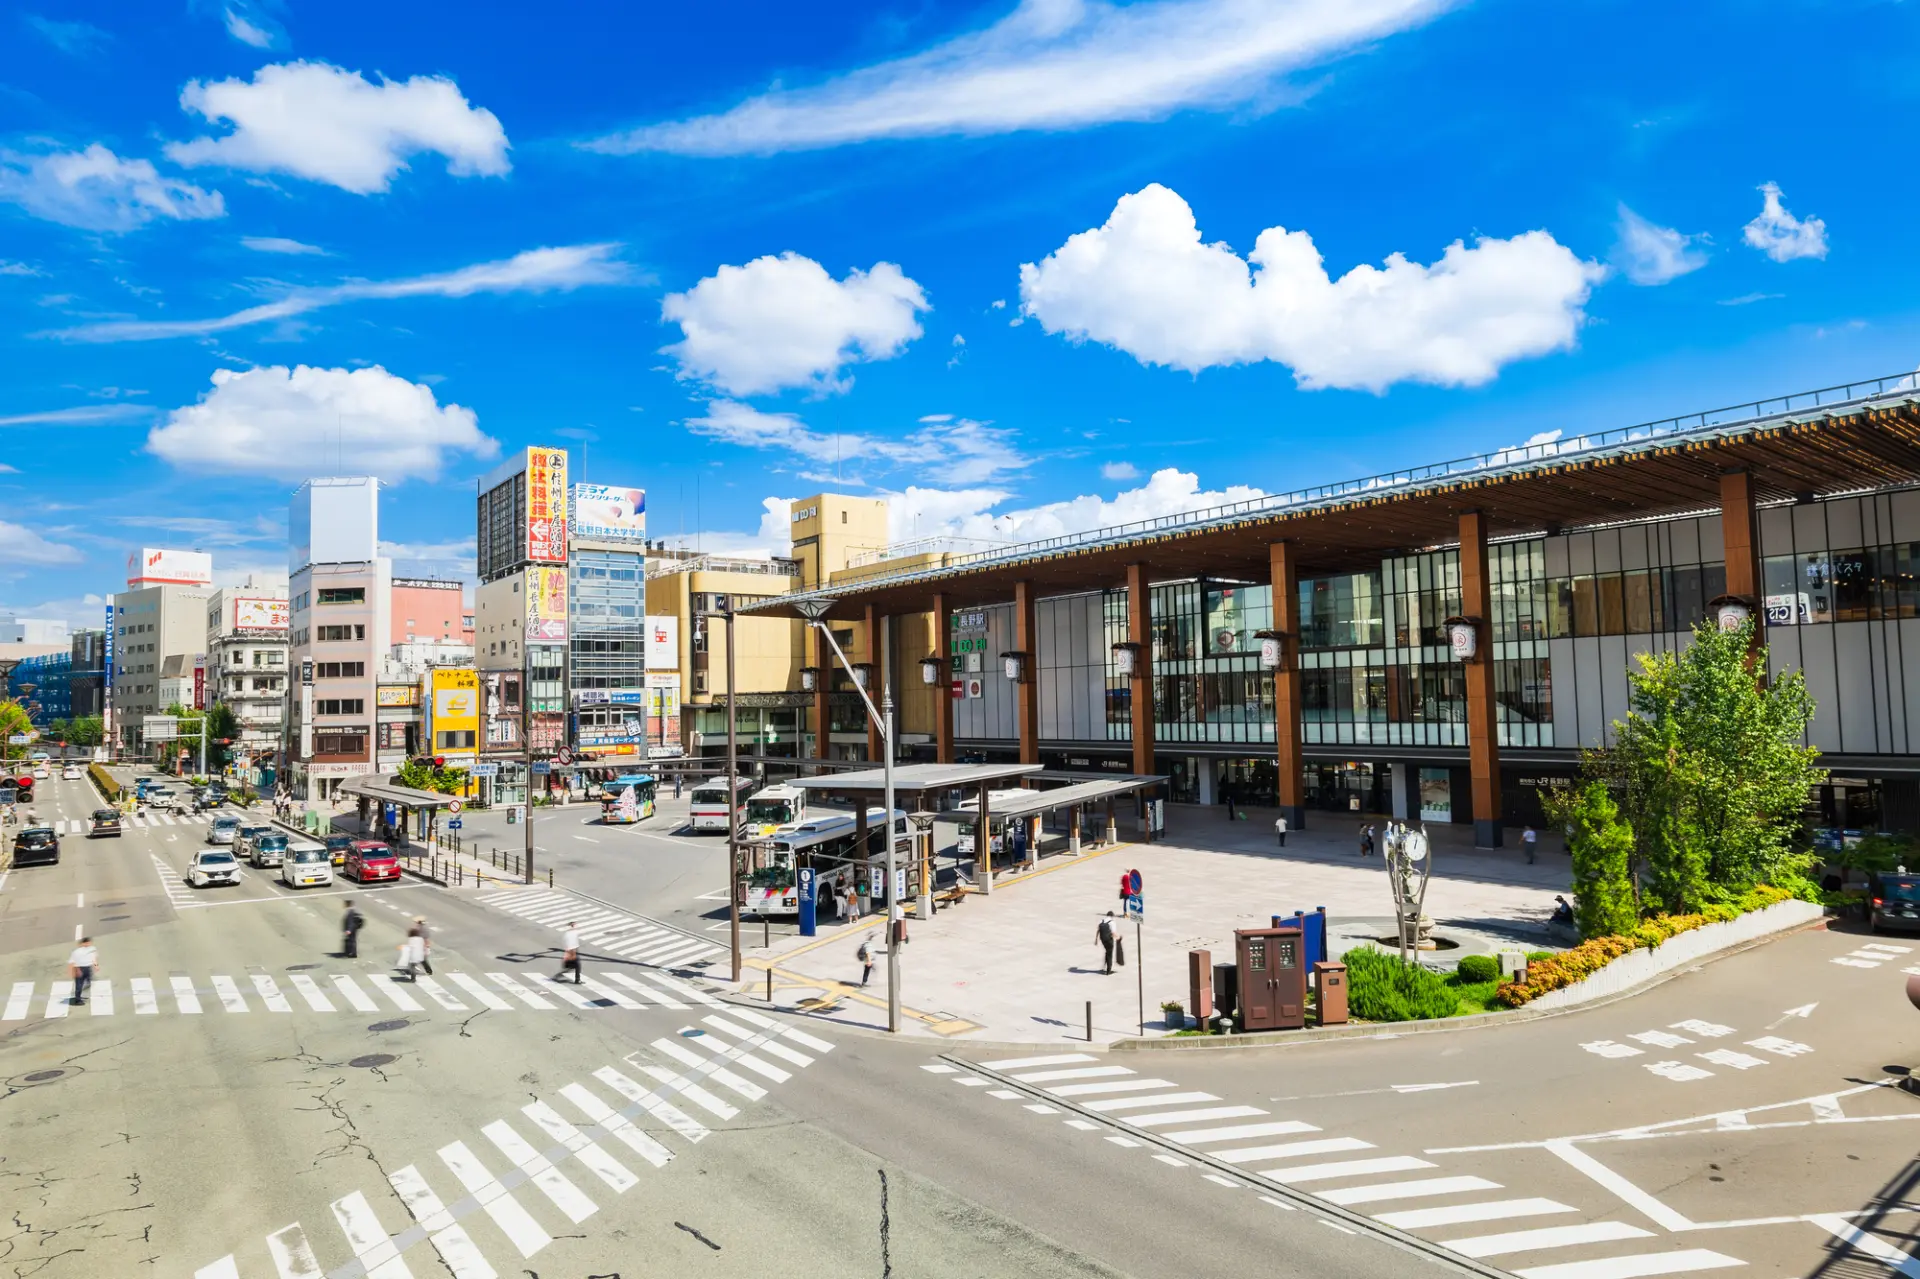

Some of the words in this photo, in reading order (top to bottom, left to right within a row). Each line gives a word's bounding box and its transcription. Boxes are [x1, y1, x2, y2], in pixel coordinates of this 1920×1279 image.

[532, 454, 546, 515] 郷土料理
[577, 485, 609, 494] ミライ
[551, 472, 562, 557] 信州長屋酒場
[1806, 561, 1862, 577] 鎌倉パスタ
[961, 613, 984, 627] 長野駅
